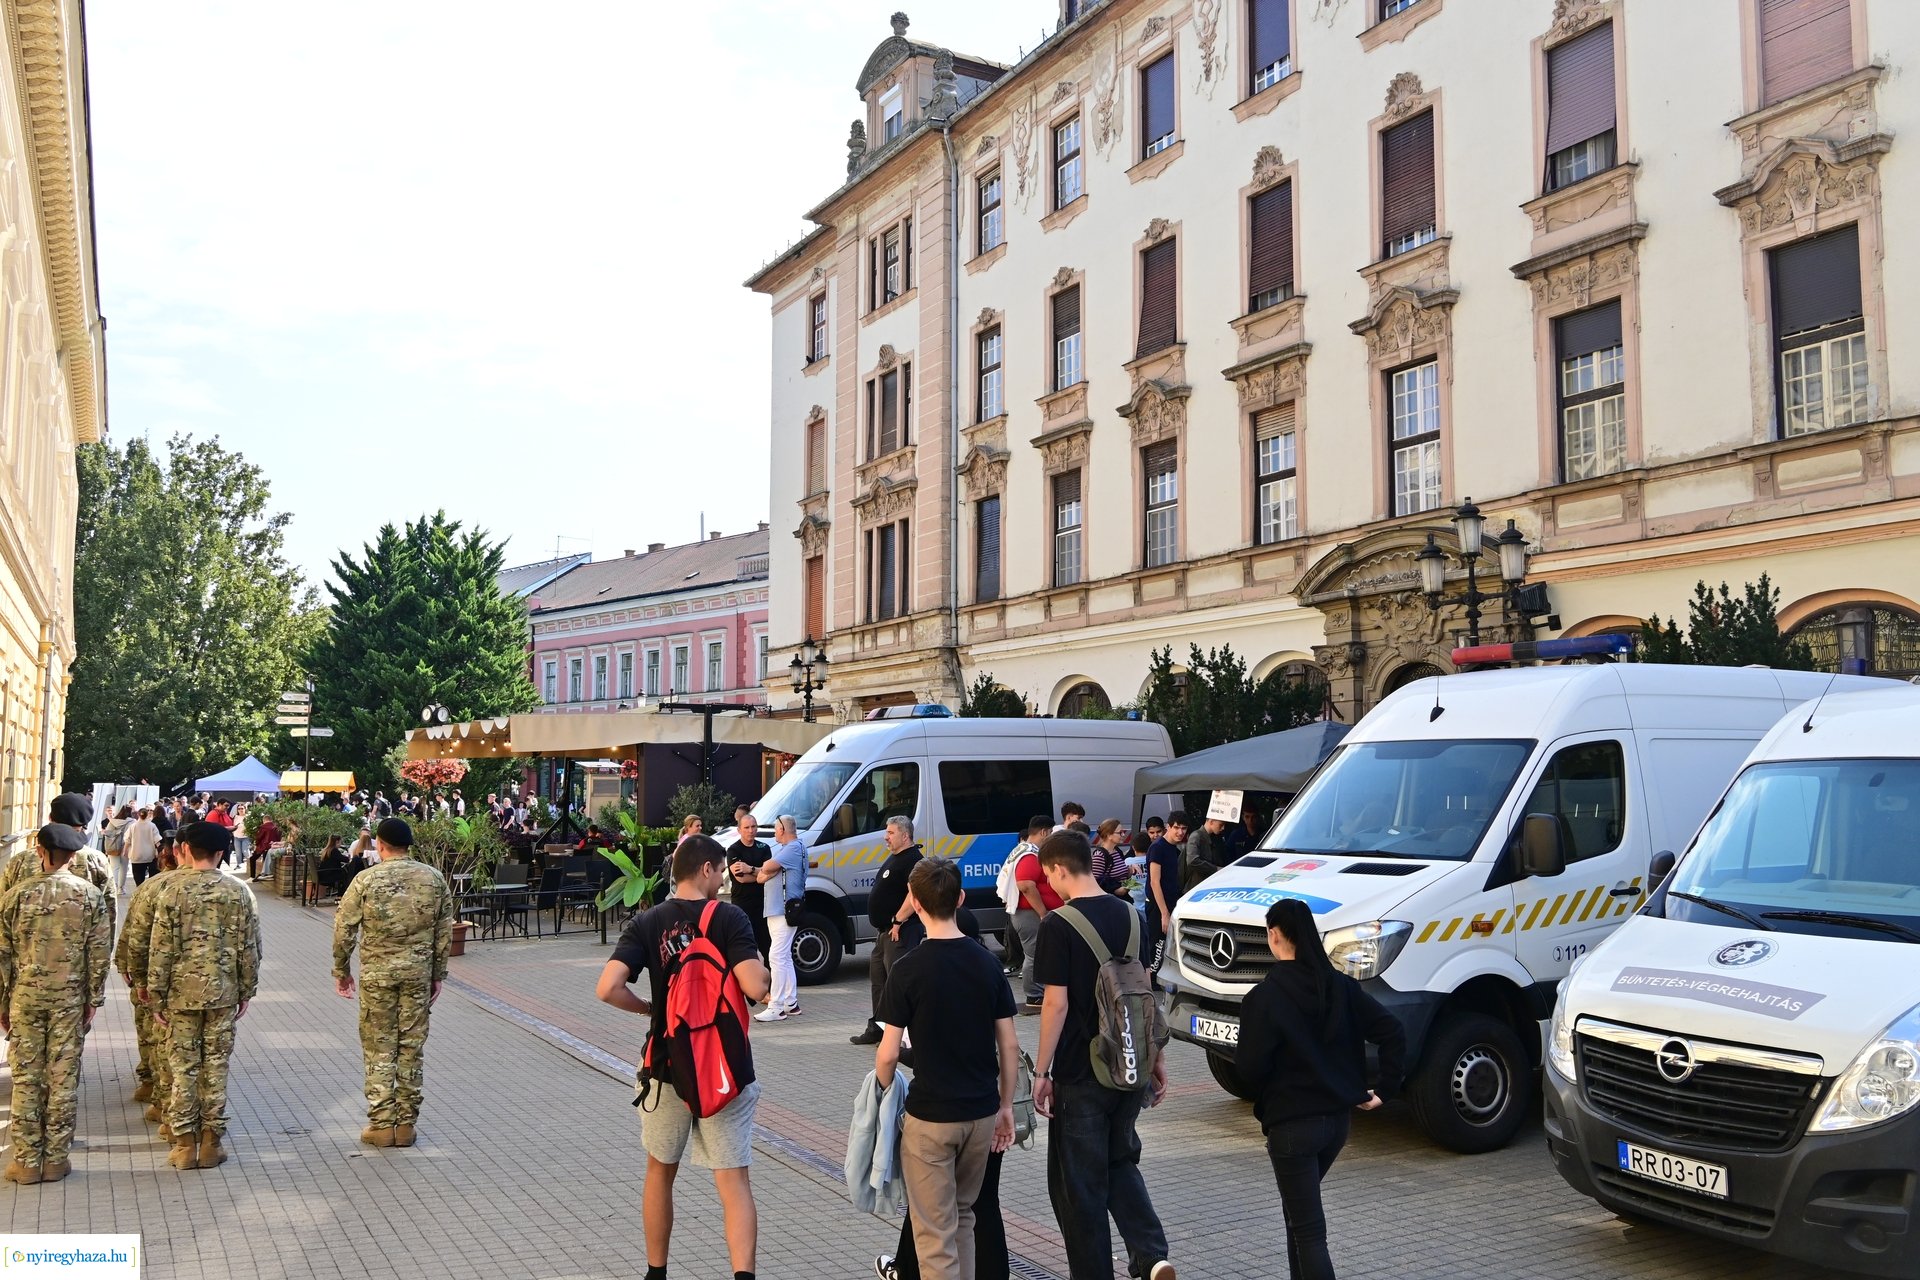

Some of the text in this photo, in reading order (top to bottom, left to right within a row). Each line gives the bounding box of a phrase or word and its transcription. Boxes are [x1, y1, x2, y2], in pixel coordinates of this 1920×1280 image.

[964, 863, 1002, 877] REND
[860, 877, 876, 888] 112
[1202, 888, 1308, 905] RENDŐRS
[1617, 974, 1804, 1012] BÜNTETÉS-VÉGREHAJTÁS
[1197, 1019, 1240, 1042] MZA-23
